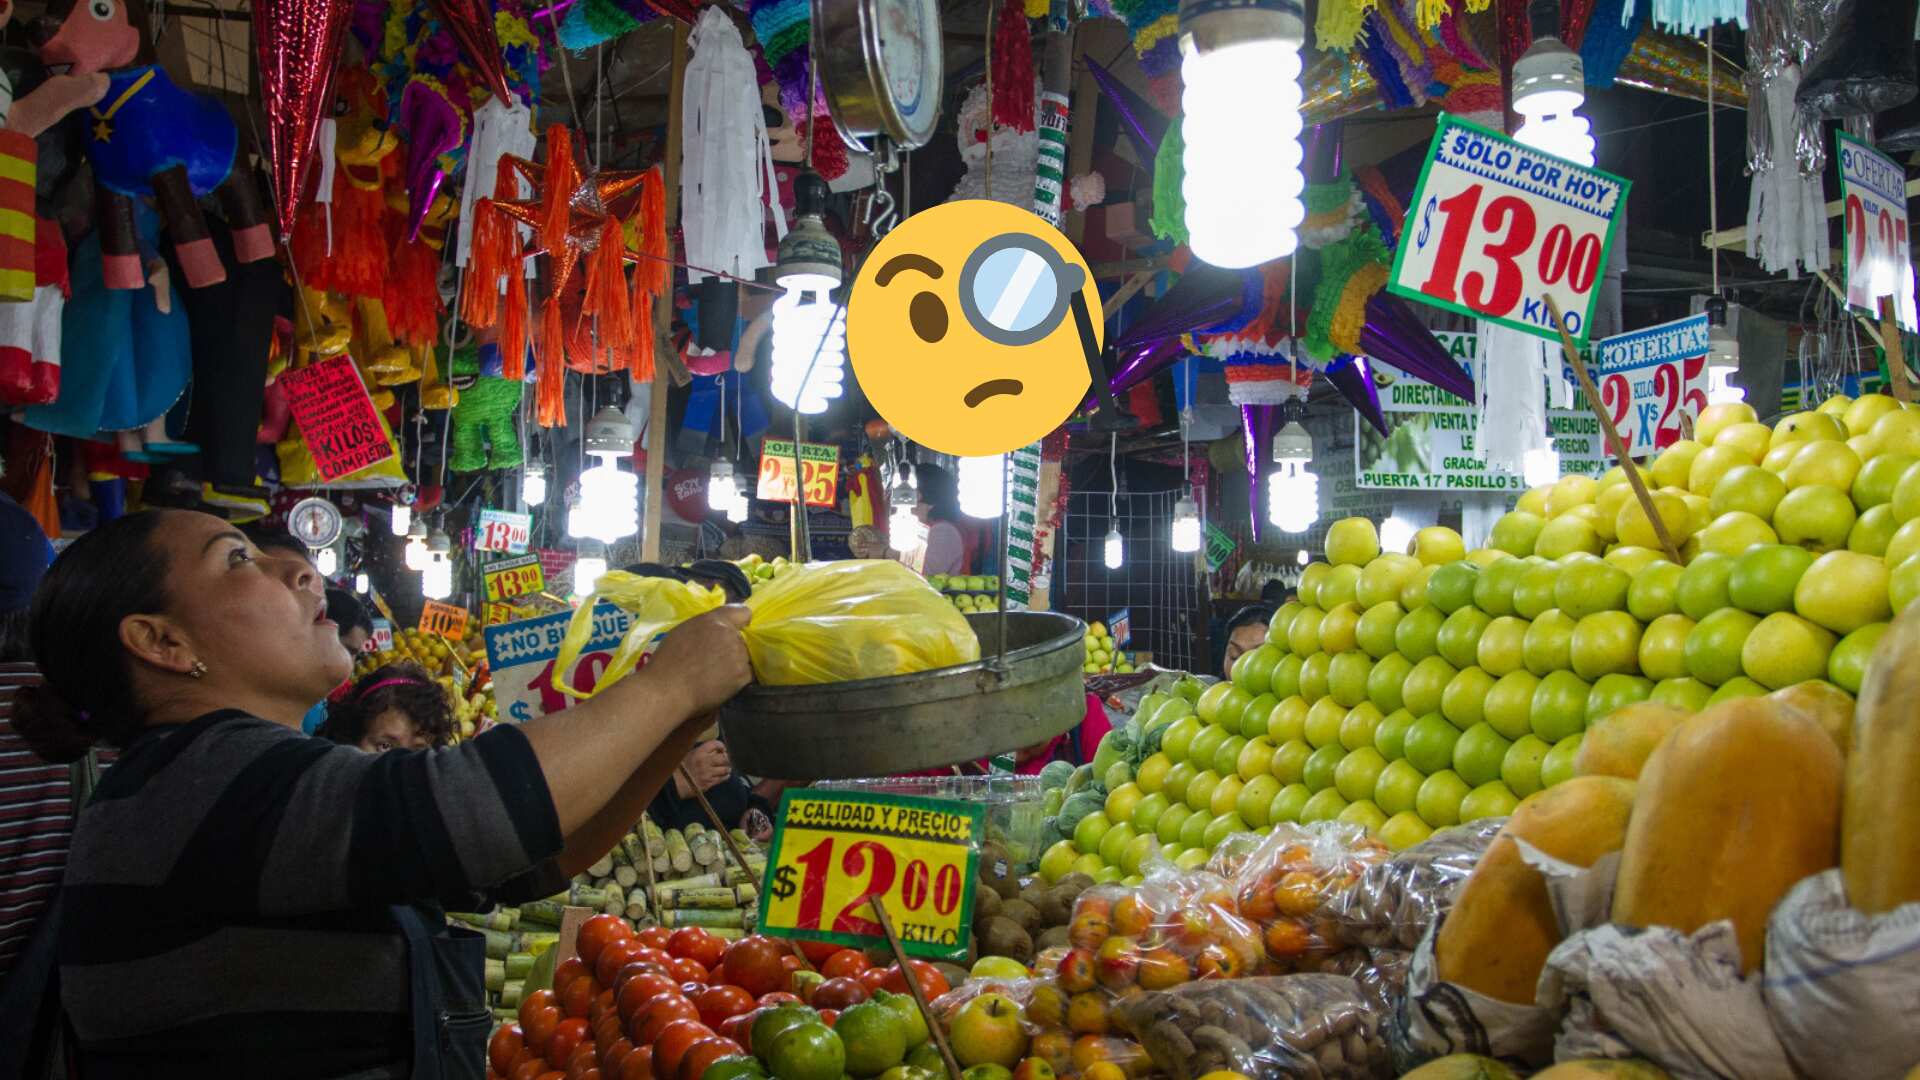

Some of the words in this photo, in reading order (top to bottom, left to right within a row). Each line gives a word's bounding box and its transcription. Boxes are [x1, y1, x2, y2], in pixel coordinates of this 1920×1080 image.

[1453, 135, 1512, 170] SOLO
[1516, 156, 1561, 187] POR
[1565, 174, 1611, 203] HOY
[1853, 151, 1899, 199] OFERTA
[1611, 329, 1701, 364] OFERTA
[1433, 413, 1469, 430] VENTA
[1602, 374, 1632, 458] 2
[1364, 474, 1420, 487] PUERTA
[1424, 475, 1442, 488] 17
[1447, 475, 1506, 489] PASILLO
[1511, 475, 1518, 489] 5
[512, 632, 541, 652] NO
[803, 803, 875, 825] CALIDAD
[882, 808, 894, 825] Y
[898, 810, 961, 833] PRECIO
